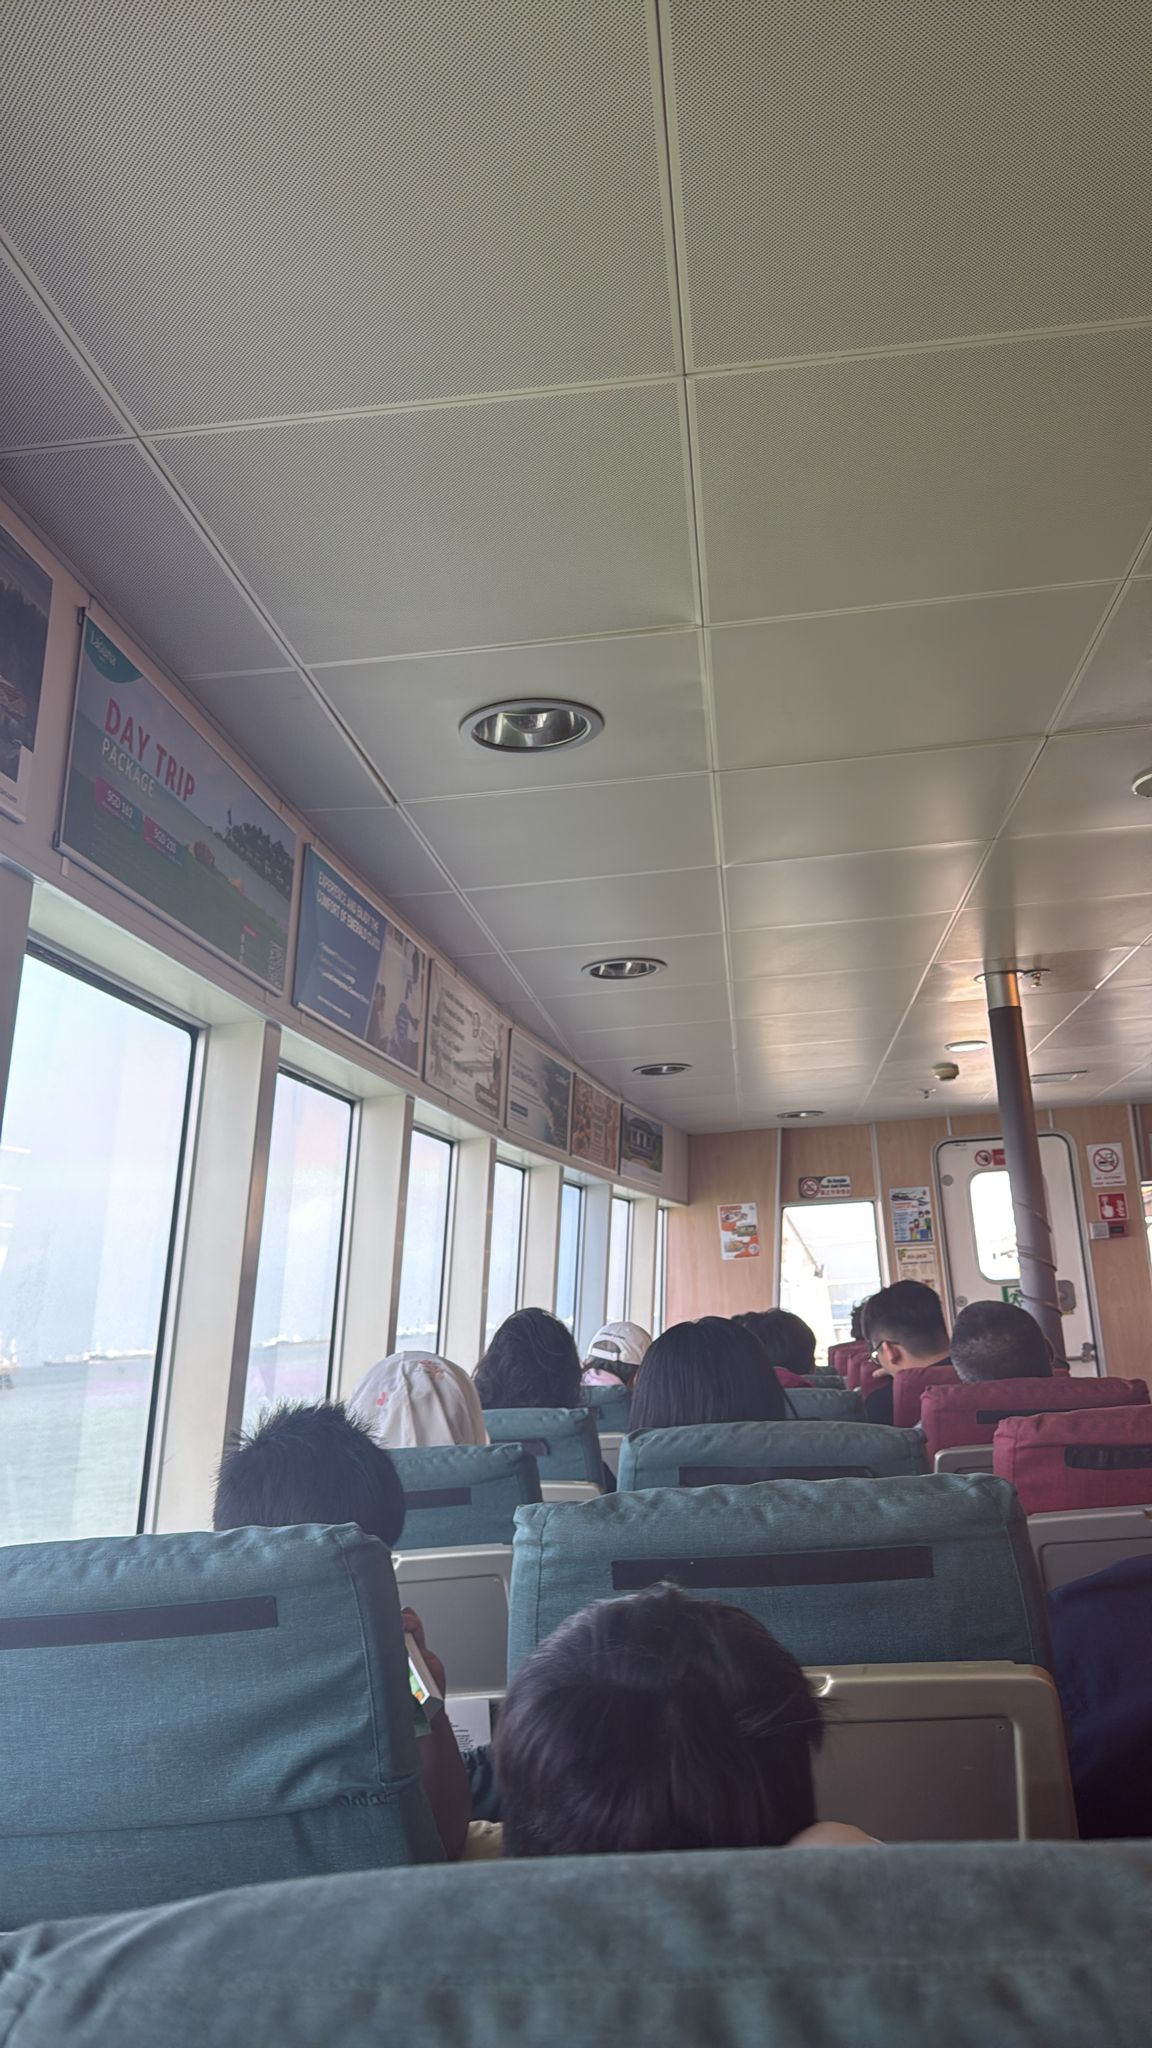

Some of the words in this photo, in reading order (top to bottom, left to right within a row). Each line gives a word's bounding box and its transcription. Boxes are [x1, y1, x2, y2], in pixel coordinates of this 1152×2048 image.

[101, 737, 155, 798] PACKAGE
[105, 697, 150, 762] DAY
[156, 743, 196, 802] TRIP
